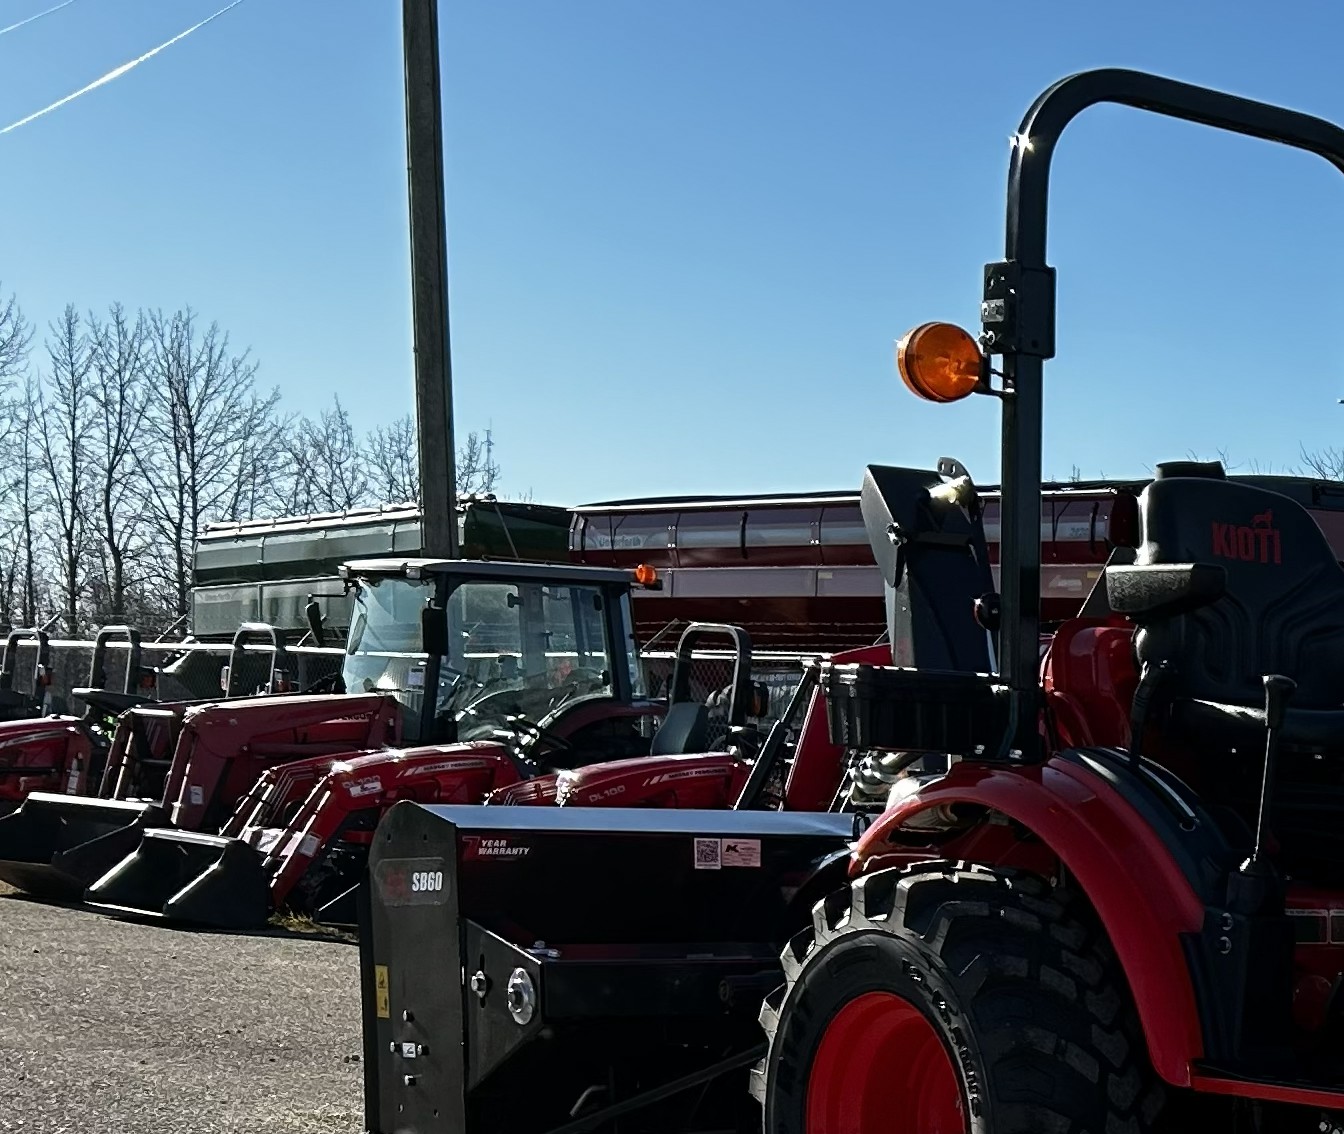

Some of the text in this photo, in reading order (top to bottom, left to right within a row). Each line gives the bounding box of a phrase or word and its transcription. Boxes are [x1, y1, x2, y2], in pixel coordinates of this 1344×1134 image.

[1211, 520, 1282, 564] KIOTI
[478, 847, 530, 856] WARRANTY
[411, 871, 443, 892] SB60
